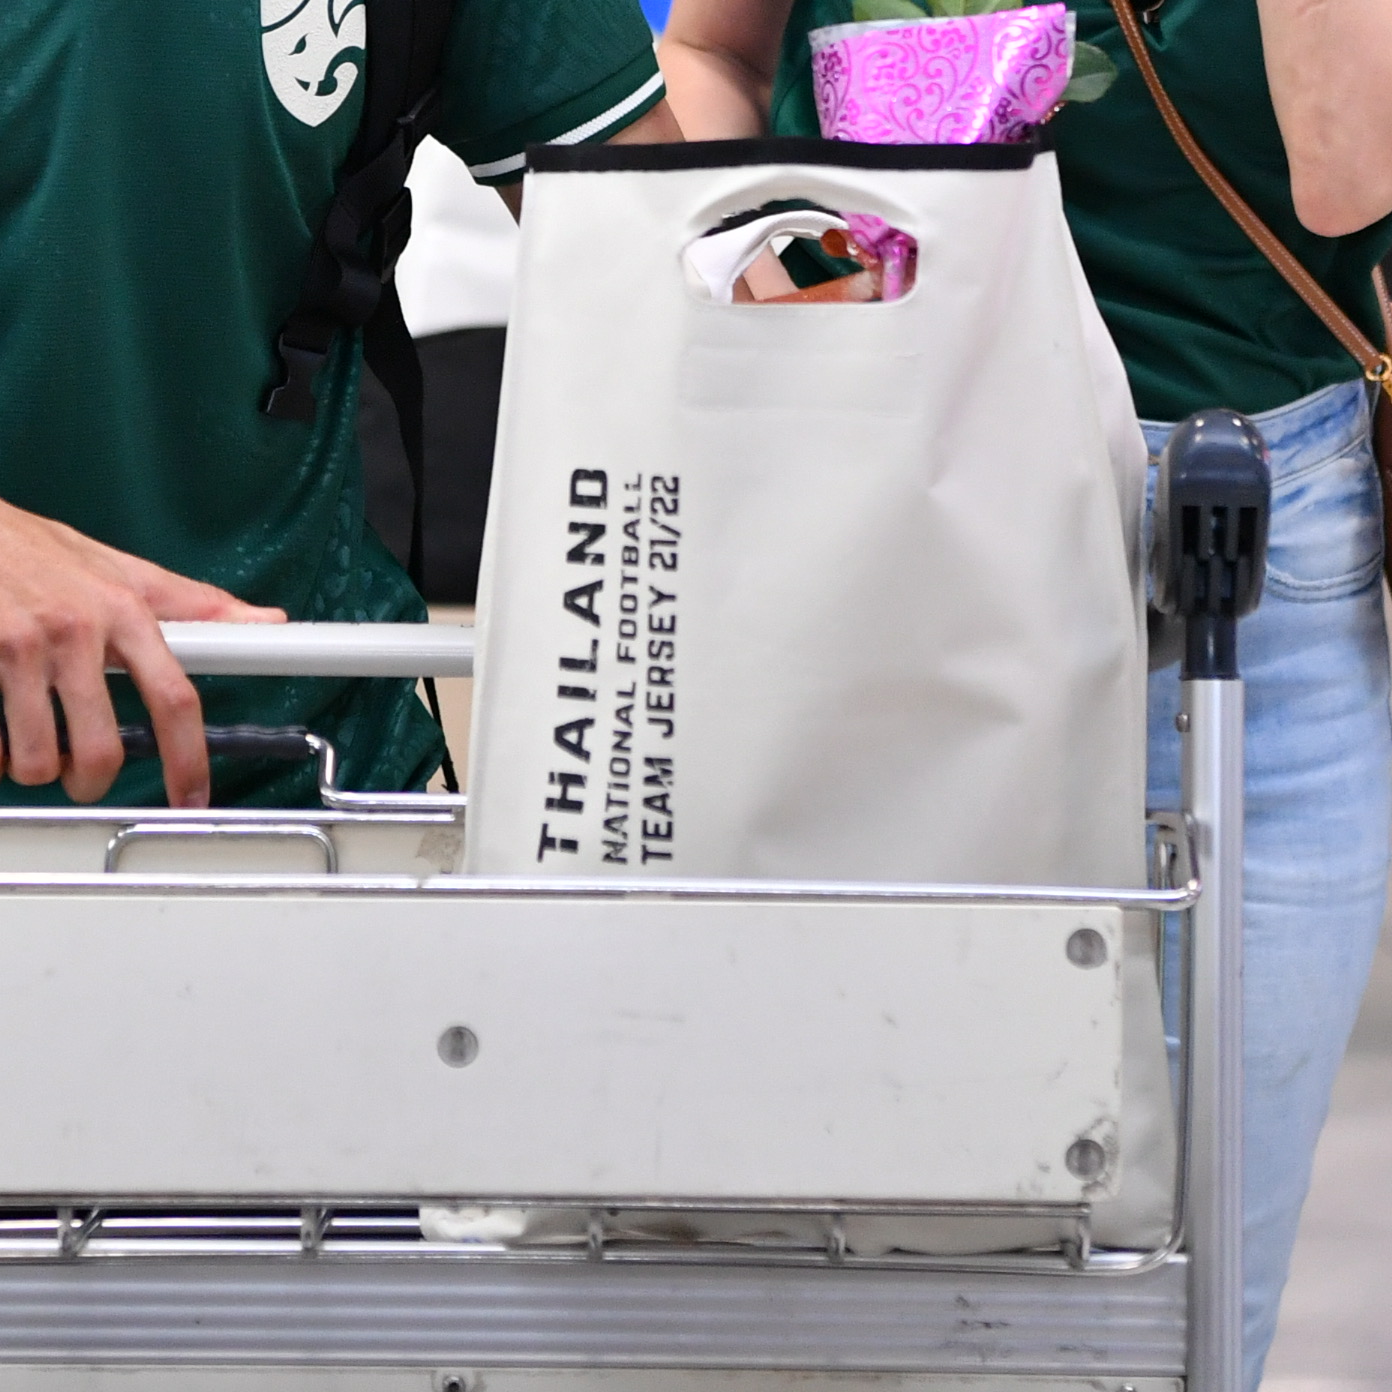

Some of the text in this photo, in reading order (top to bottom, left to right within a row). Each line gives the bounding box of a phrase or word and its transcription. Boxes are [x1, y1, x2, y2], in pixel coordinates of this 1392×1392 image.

[537, 468, 609, 863] THAILAND
[602, 472, 643, 865] NATIONAL FOOTBALL
[641, 474, 681, 865] TEAM JERSEY 21/22
